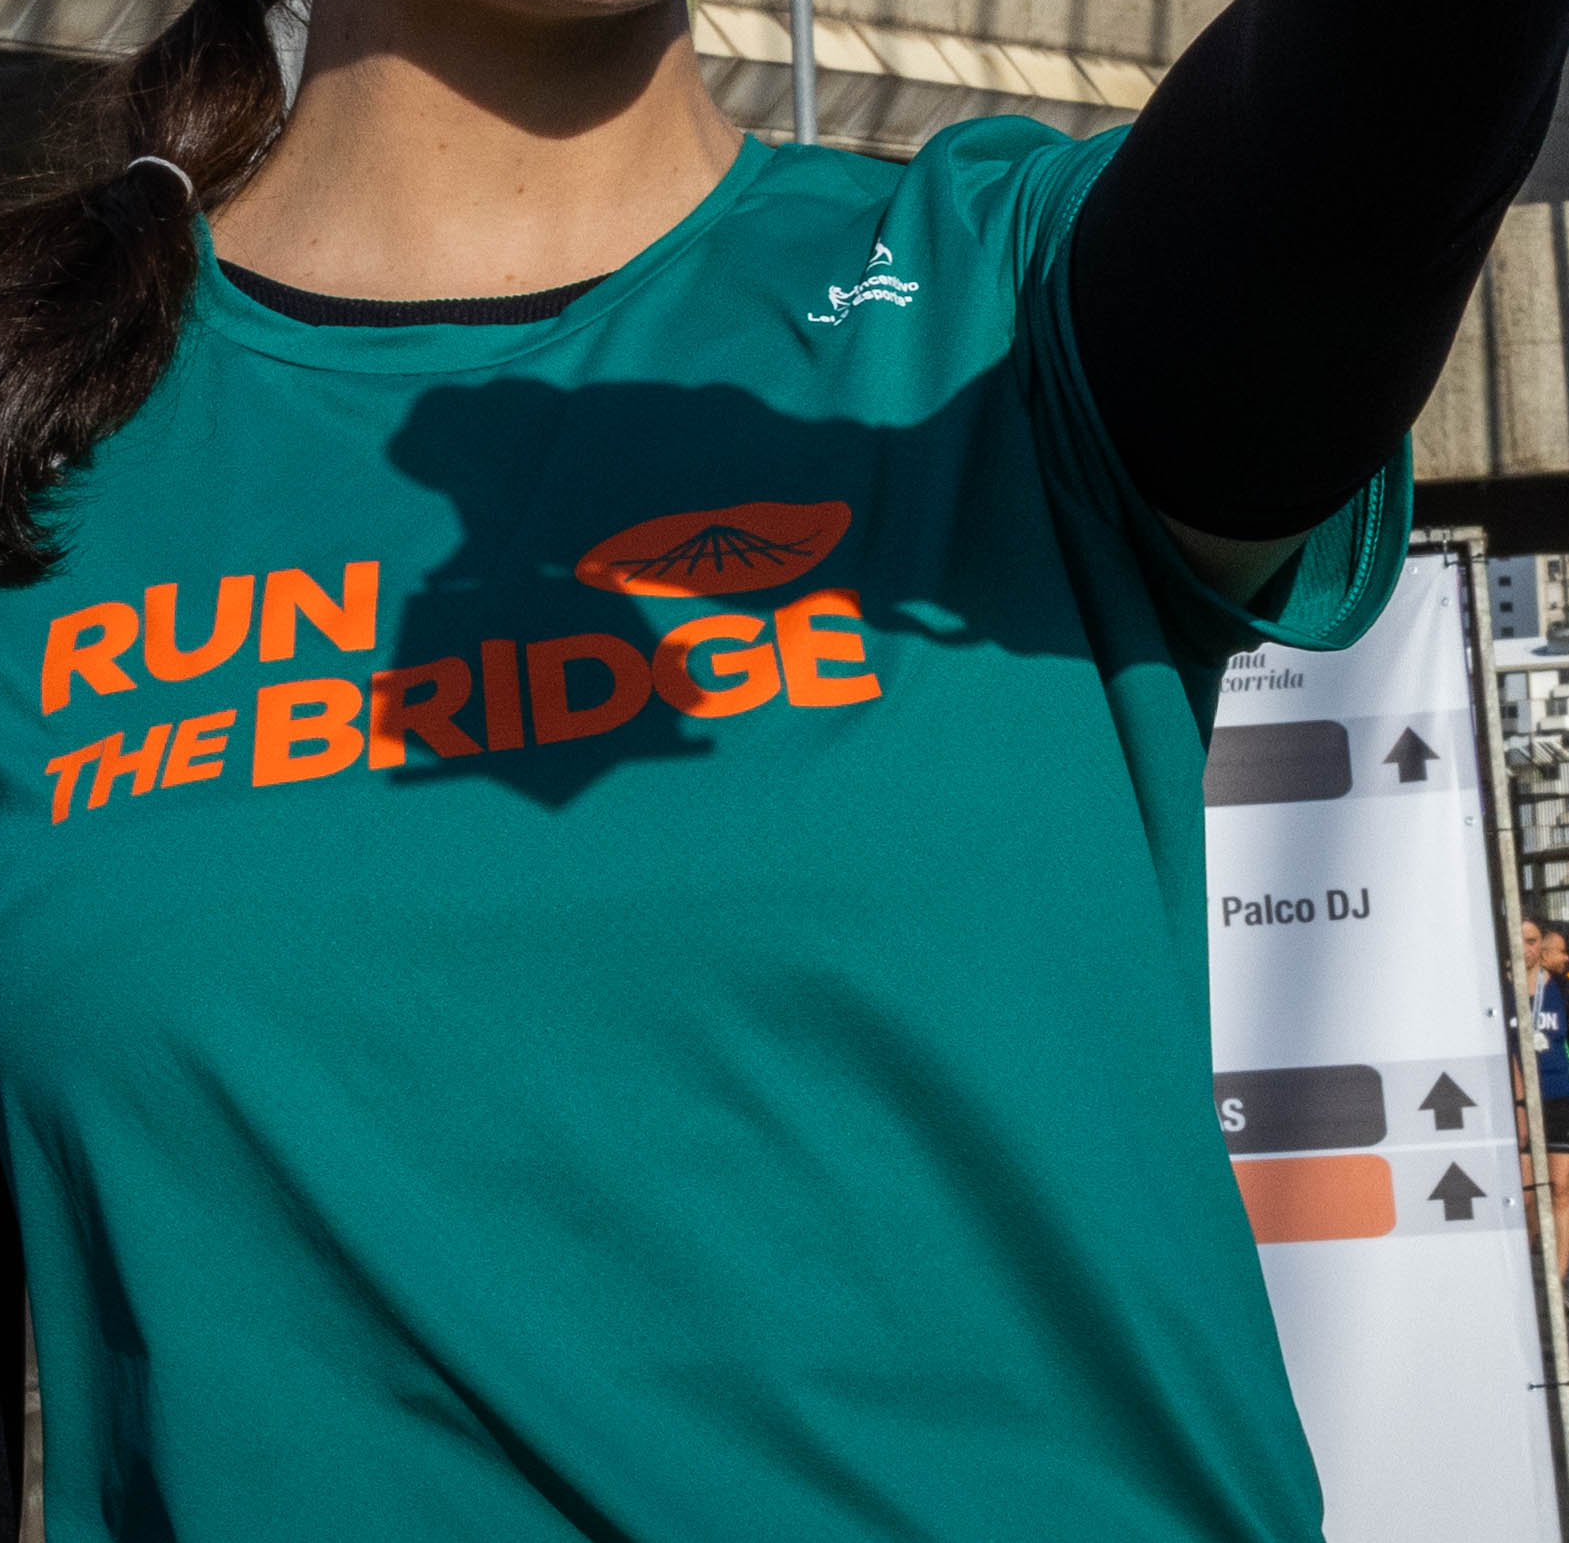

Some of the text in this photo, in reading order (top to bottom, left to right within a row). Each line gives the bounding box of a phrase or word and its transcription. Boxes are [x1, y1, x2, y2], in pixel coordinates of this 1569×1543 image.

[42, 560, 380, 716] RUN
[1221, 669, 1304, 692] corrida
[43, 588, 883, 825] THE BRIDGE
[1222, 887, 1370, 927] Palco DJ
